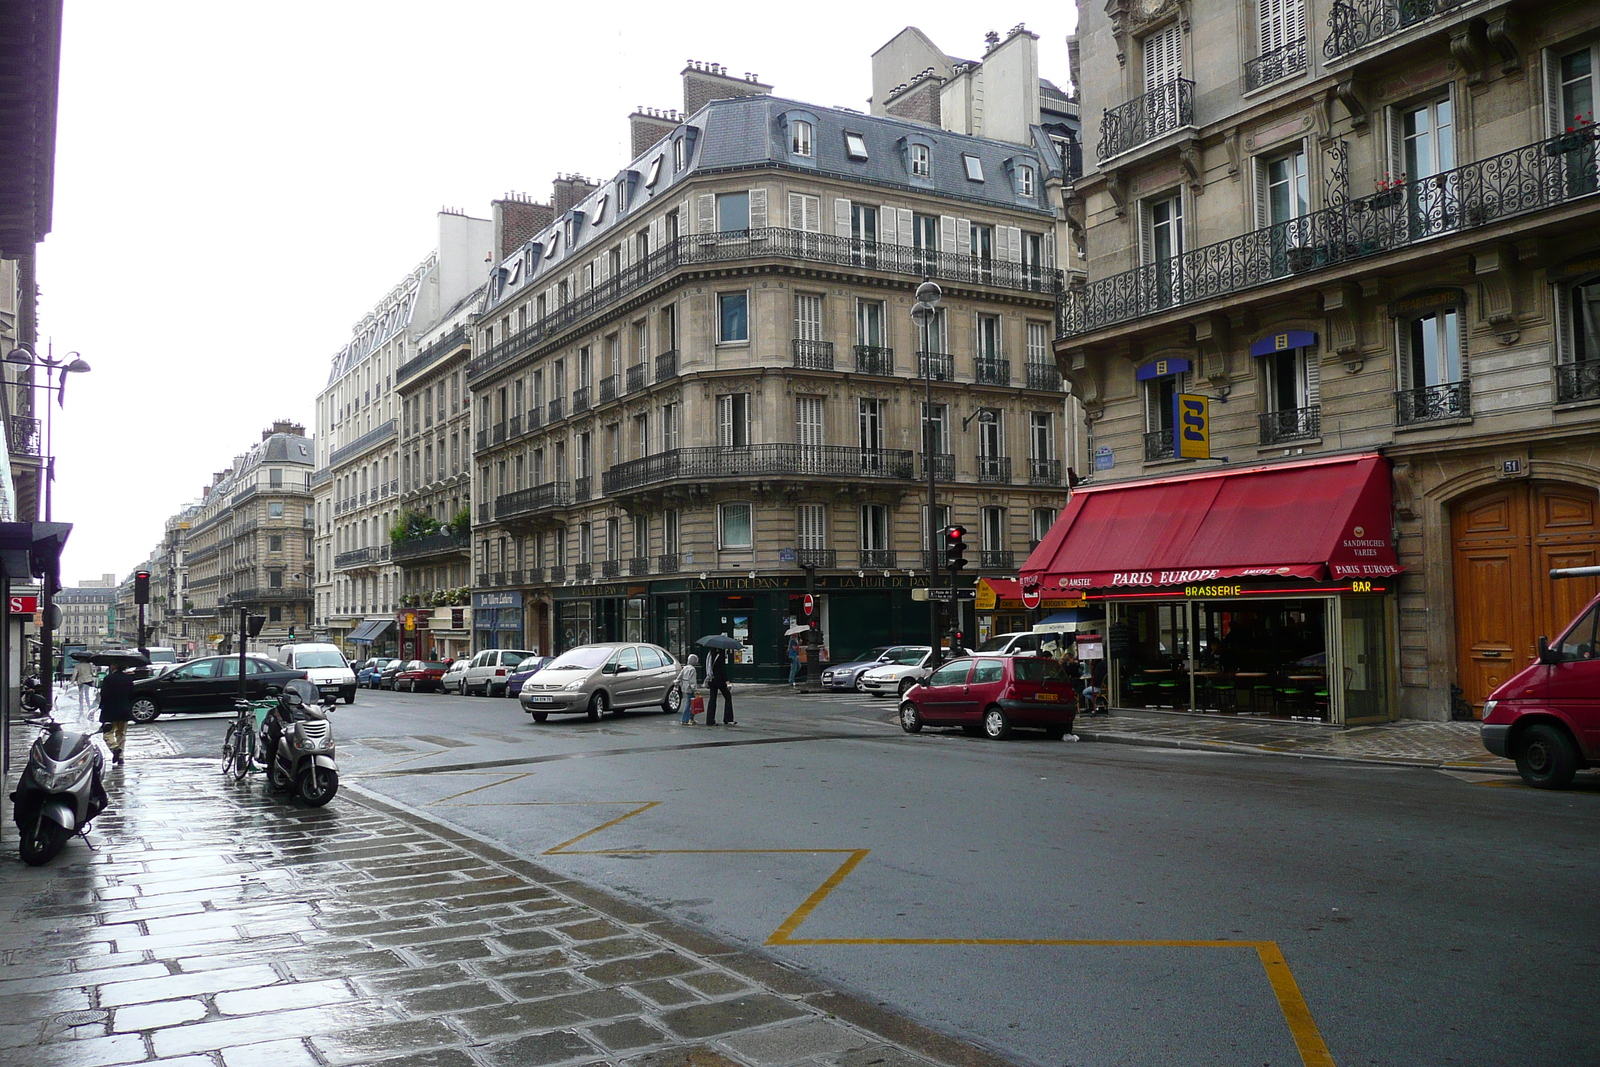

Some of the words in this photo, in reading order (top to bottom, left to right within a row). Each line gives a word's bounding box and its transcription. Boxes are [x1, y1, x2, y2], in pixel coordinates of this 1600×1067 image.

[1506, 461, 1517, 471] 51
[1335, 565, 1360, 574] PARIS
[1363, 565, 1397, 573] EUROPE
[1112, 572, 1153, 584] PARIS
[1159, 569, 1219, 583] EUROPE
[691, 579, 706, 589] LA
[708, 579, 735, 589] FLUTE
[737, 579, 750, 589] DE
[752, 578, 779, 588] PAN
[840, 578, 855, 587] LA
[860, 578, 887, 587] FLUTE
[892, 578, 903, 587] DE
[1069, 578, 1091, 586] AMSTEL
[1352, 581, 1371, 592] BAR
[1185, 586, 1241, 596] BRASSERIE
[11, 598, 22, 612] S
